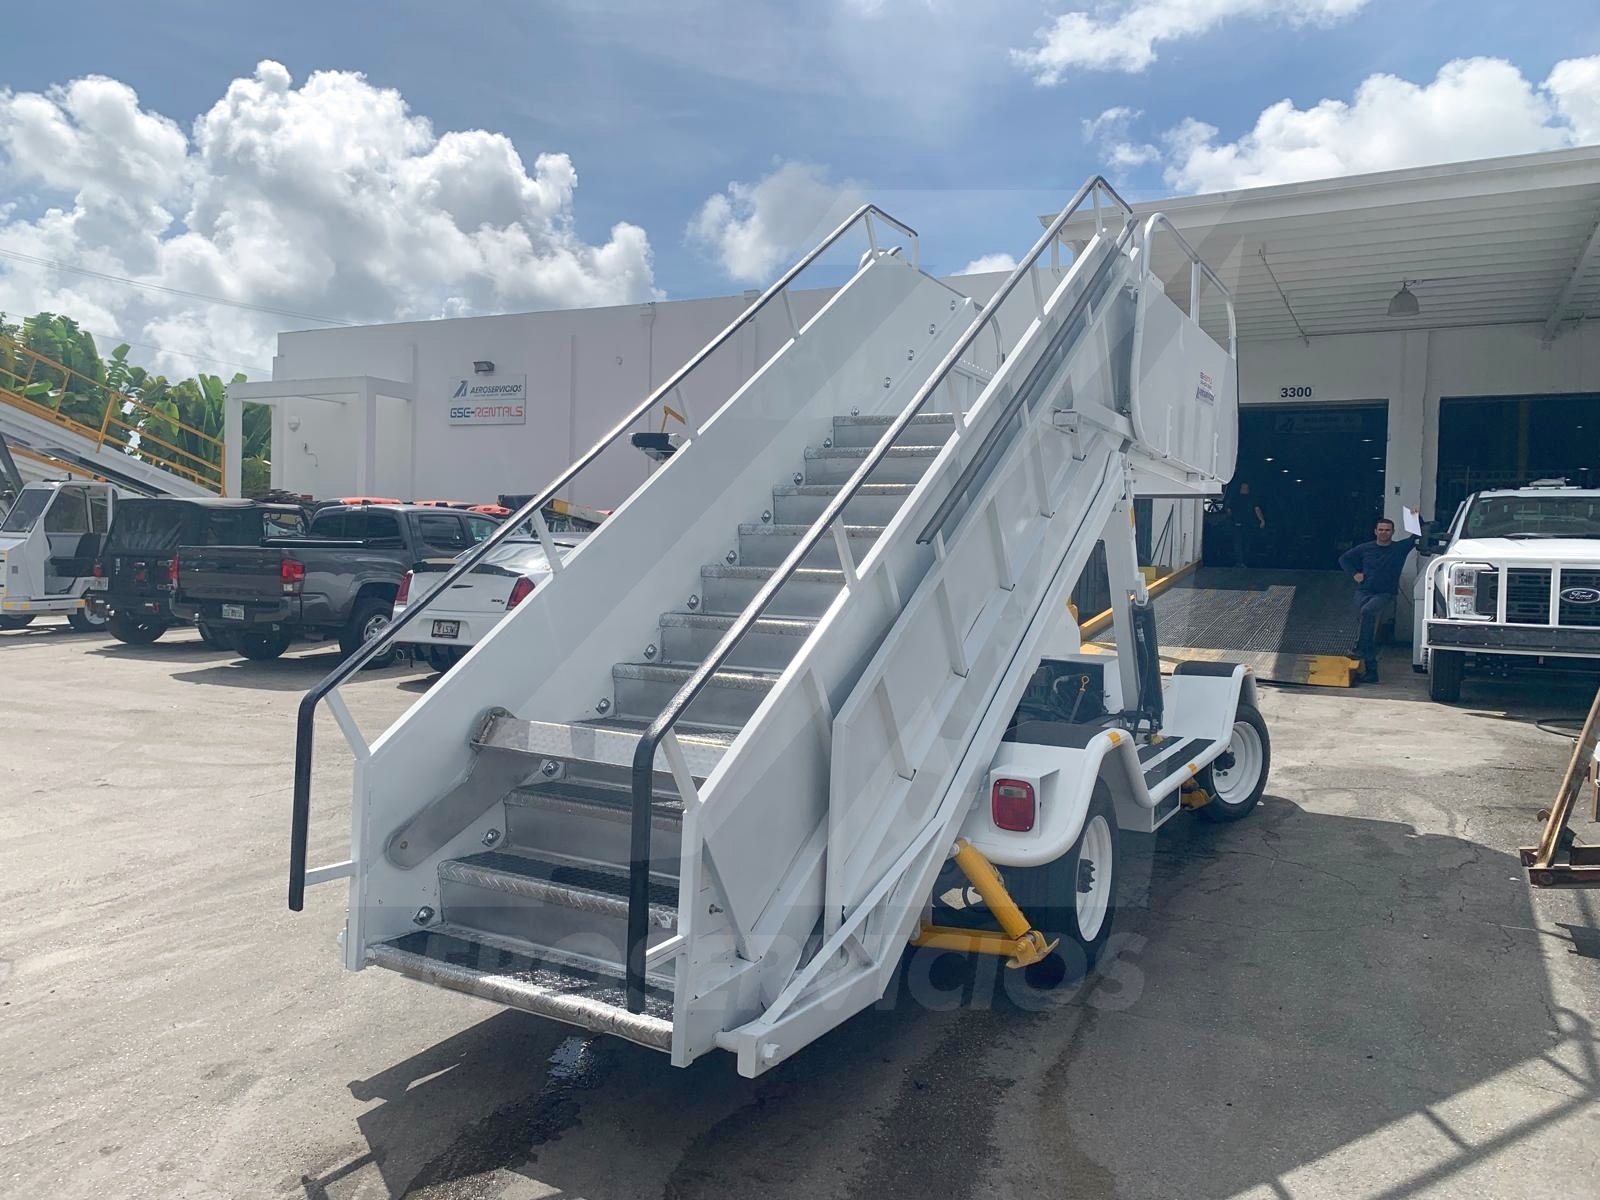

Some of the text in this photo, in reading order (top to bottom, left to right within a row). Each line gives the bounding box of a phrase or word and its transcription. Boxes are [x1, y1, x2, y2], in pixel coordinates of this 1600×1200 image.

[470, 385, 522, 394] AEROSERVICIOS
[1280, 386, 1312, 398] 3300
[450, 407, 523, 418] GSE-RENTALS
[1569, 591, 1594, 600] Ford
